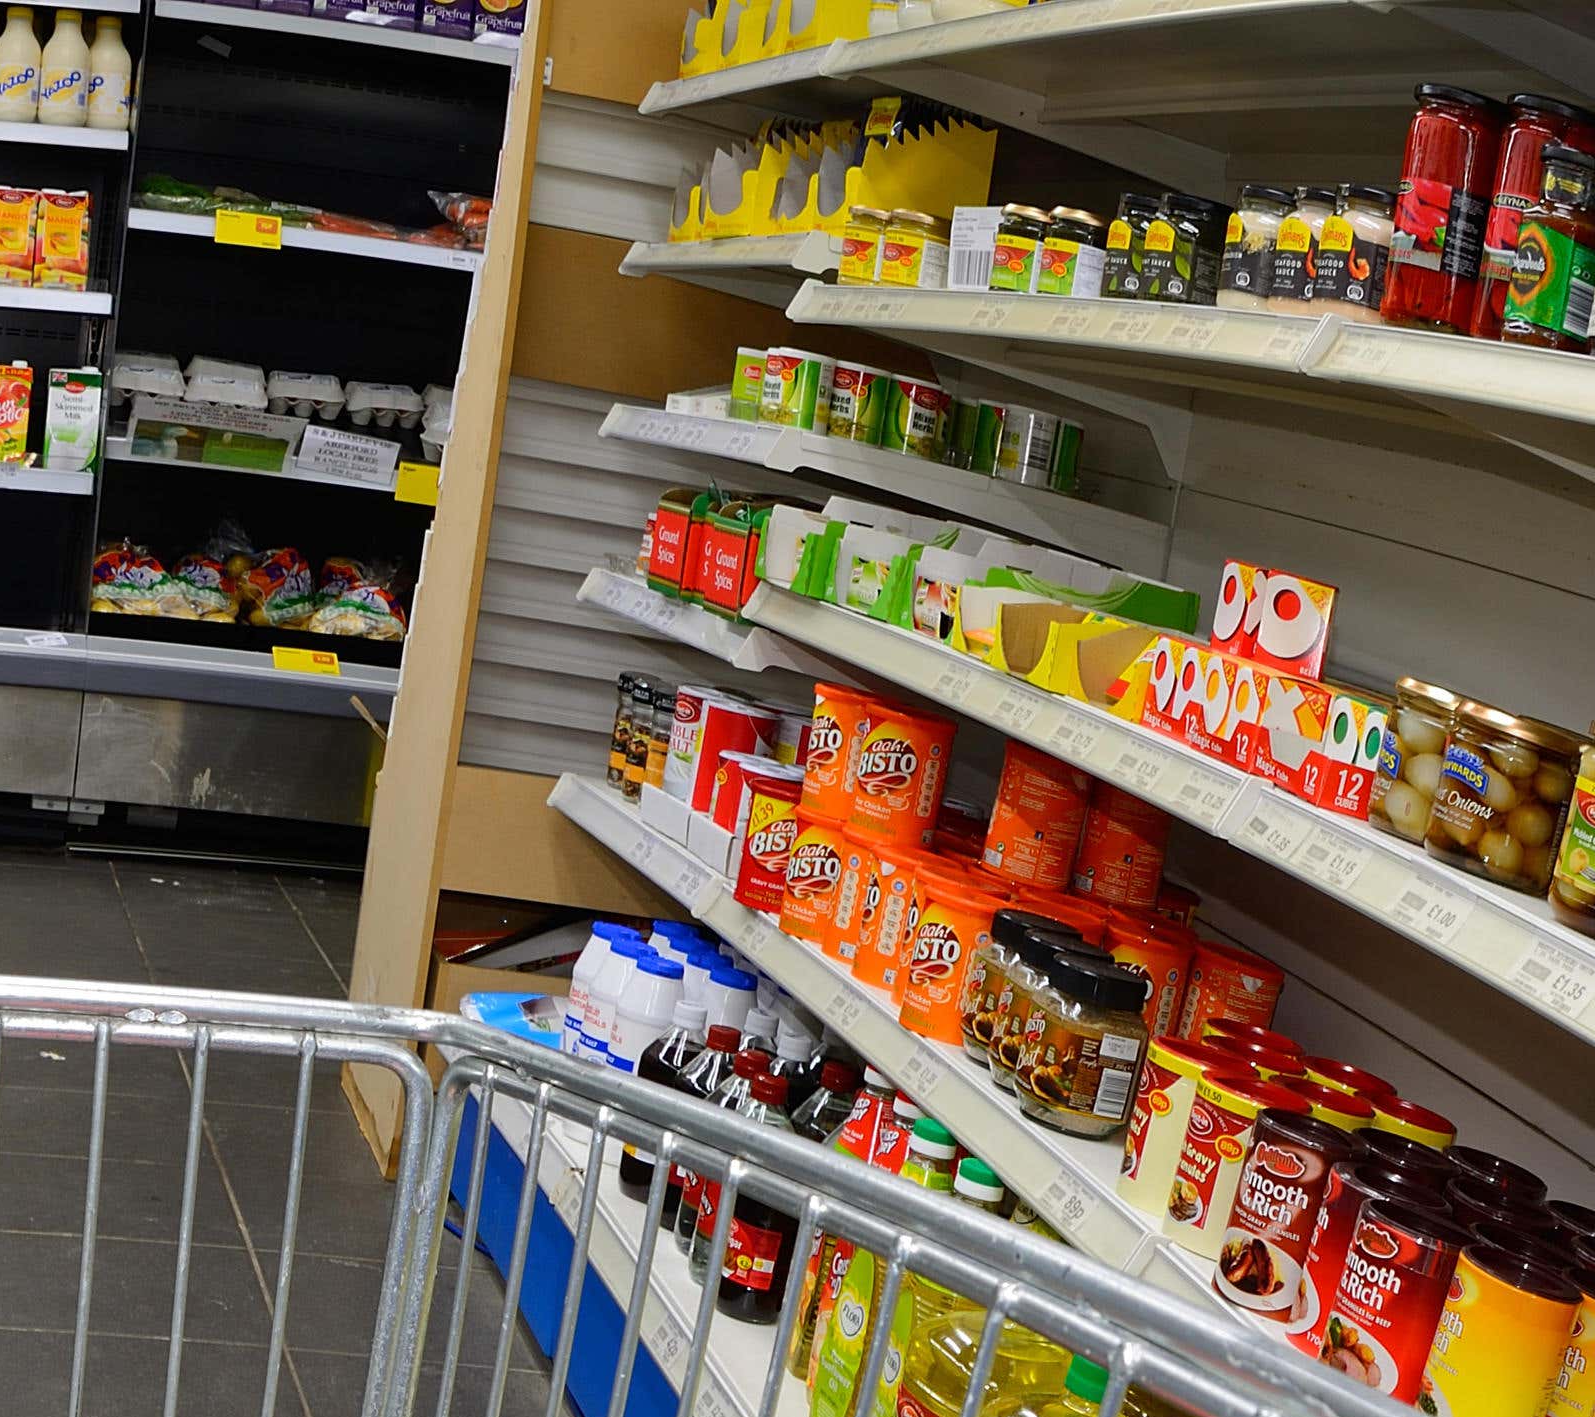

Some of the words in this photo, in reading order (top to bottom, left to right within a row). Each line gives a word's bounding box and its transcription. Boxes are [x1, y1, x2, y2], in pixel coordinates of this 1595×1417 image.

[41, 71, 81, 100] YAZOO
[912, 418, 934, 434] Herbs
[914, 410, 936, 426] Mixed
[715, 570, 733, 592] Spices
[873, 739, 909, 752] aah!
[859, 752, 917, 775] BISTO
[1304, 764, 1319, 786] 12
[1338, 769, 1364, 800] 12
[1334, 798, 1359, 812] CUBES
[1448, 792, 1494, 821] Onions
[787, 858, 841, 880] BISTO
[792, 904, 817, 918] Chicken
[1427, 903, 1457, 928] £1.00
[1552, 975, 1587, 1001] £1.35
[1016, 1044, 1039, 1071] Best
[1186, 1142, 1216, 1173] Gravy
[1242, 1163, 1308, 1209] Smooth
[842, 1303, 862, 1326] FLORA
